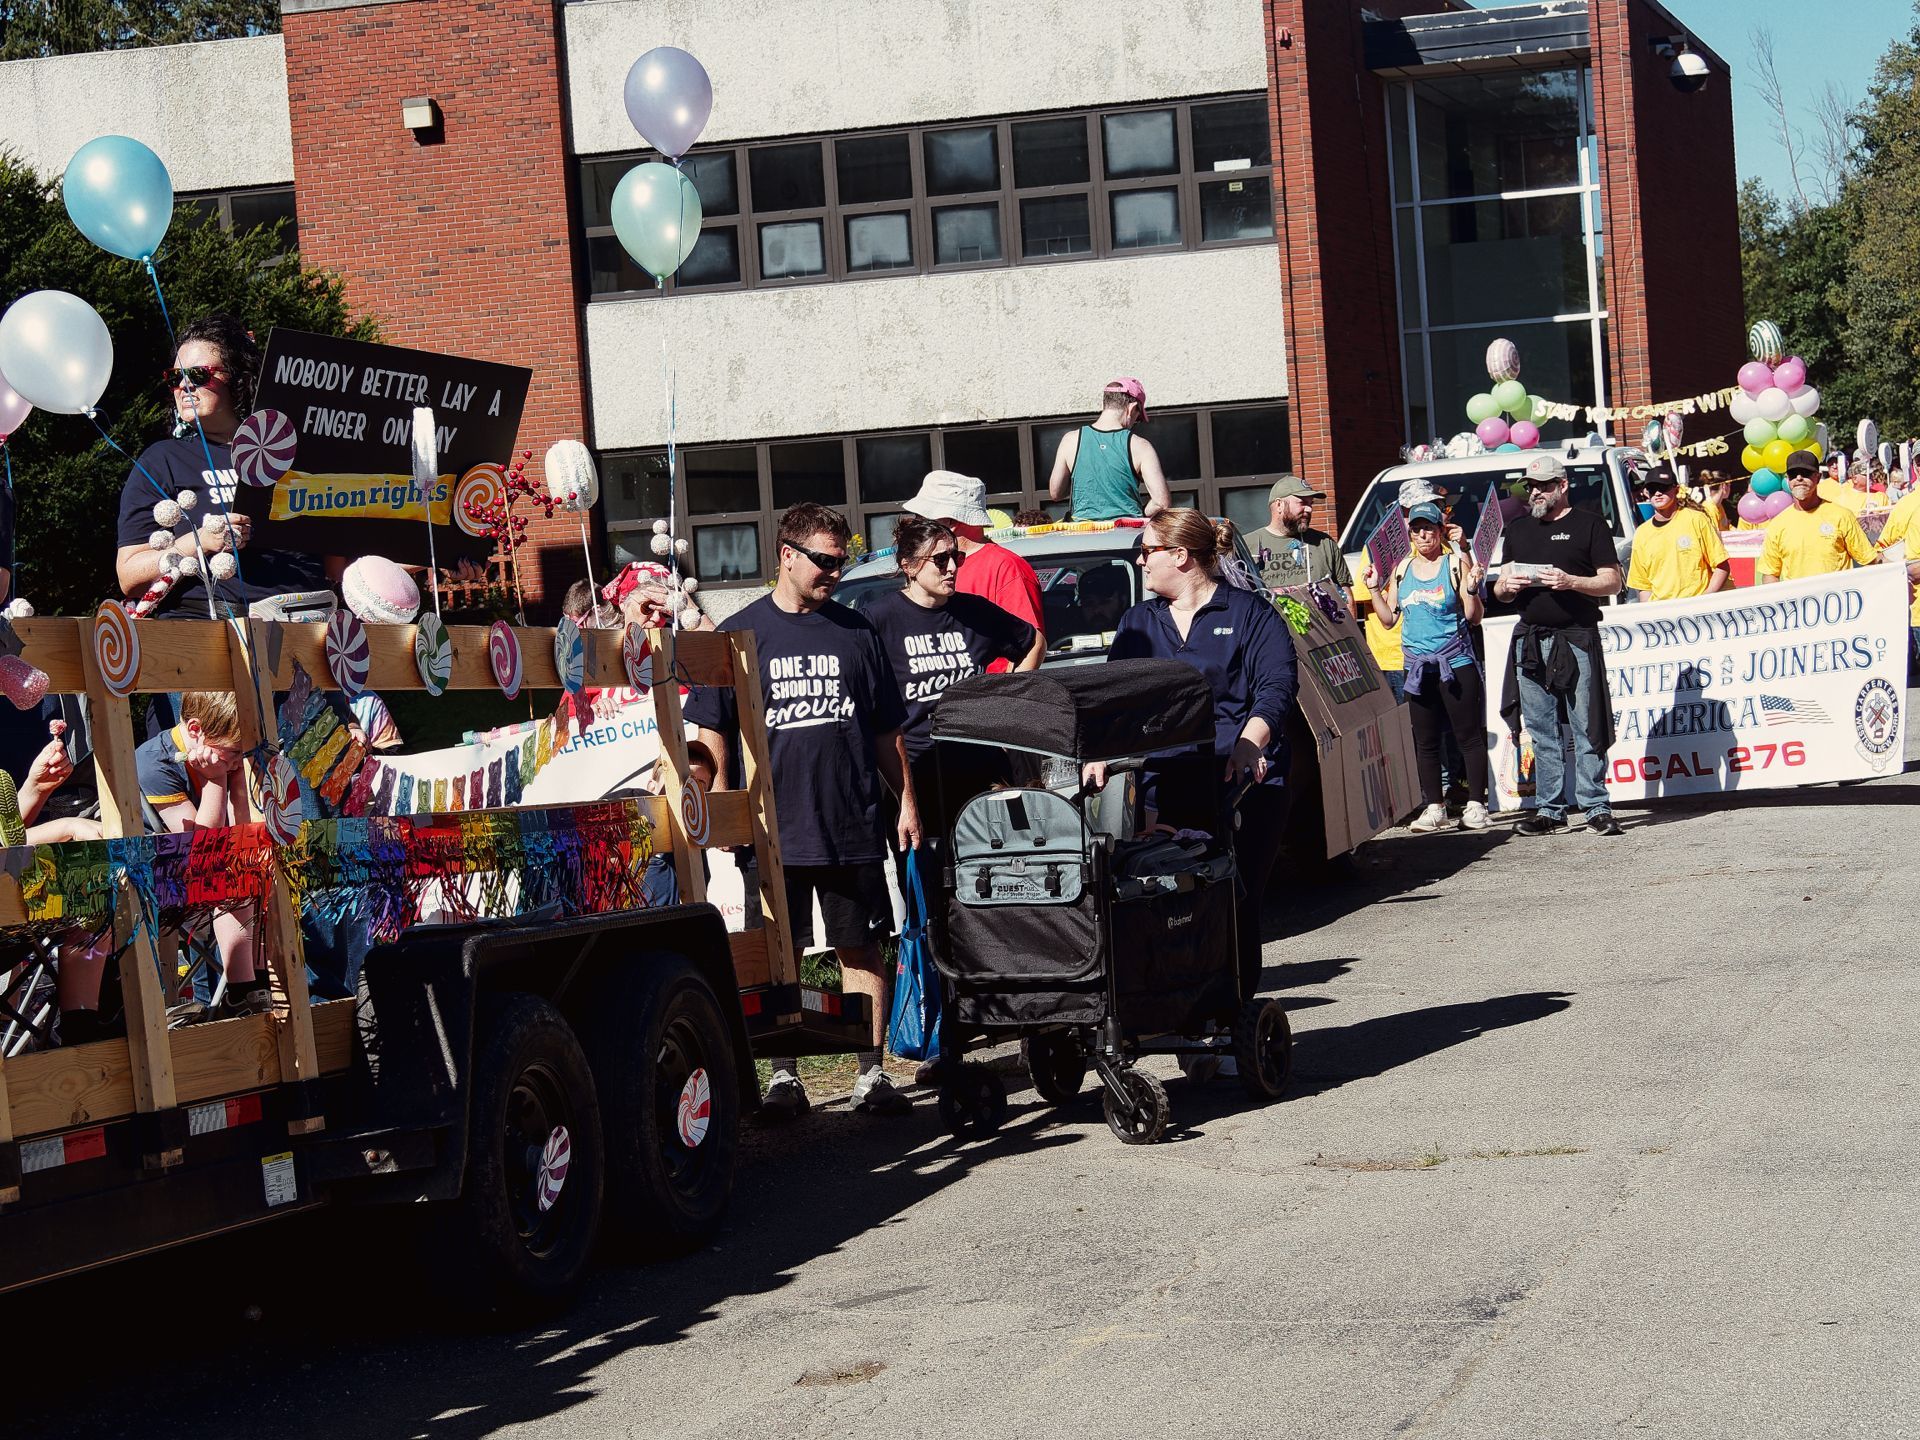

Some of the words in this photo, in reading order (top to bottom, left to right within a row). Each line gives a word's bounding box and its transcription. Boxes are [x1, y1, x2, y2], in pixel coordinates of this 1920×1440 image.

[275, 355, 354, 393] NOBODY
[361, 367, 428, 403] BETTER
[441, 381, 477, 412] LAY
[488, 389, 501, 416] A
[303, 406, 367, 441] FINGER
[382, 417, 411, 446] ON
[1535, 400, 1580, 421] START
[1585, 406, 1629, 424] YOUR
[1551, 532, 1570, 541] cake
[1636, 589, 1865, 649] BROTHERHOOD
[904, 634, 936, 656] ONE
[937, 632, 966, 653] JOB
[1742, 634, 1873, 684] JOINERS
[770, 658, 802, 680] ONE
[806, 655, 839, 677] JOB
[909, 654, 957, 674] SHOULD
[956, 652, 974, 668] BE
[771, 680, 823, 700] SHOULD
[824, 679, 839, 697] BE
[906, 665, 984, 699] ENOU
[1856, 679, 1899, 711] CARPENTERS
[765, 696, 856, 728] ENOUGH
[1623, 696, 1761, 741] AMERICA
[553, 727, 617, 755] LFRED
[1855, 716, 1877, 753] WESTERN
[1877, 737, 1892, 753] NEW
[1889, 713, 1899, 737] YORK
[1604, 752, 1714, 784] OCAL
[1727, 741, 1806, 773] 276
[997, 884, 1025, 893] QUEST
